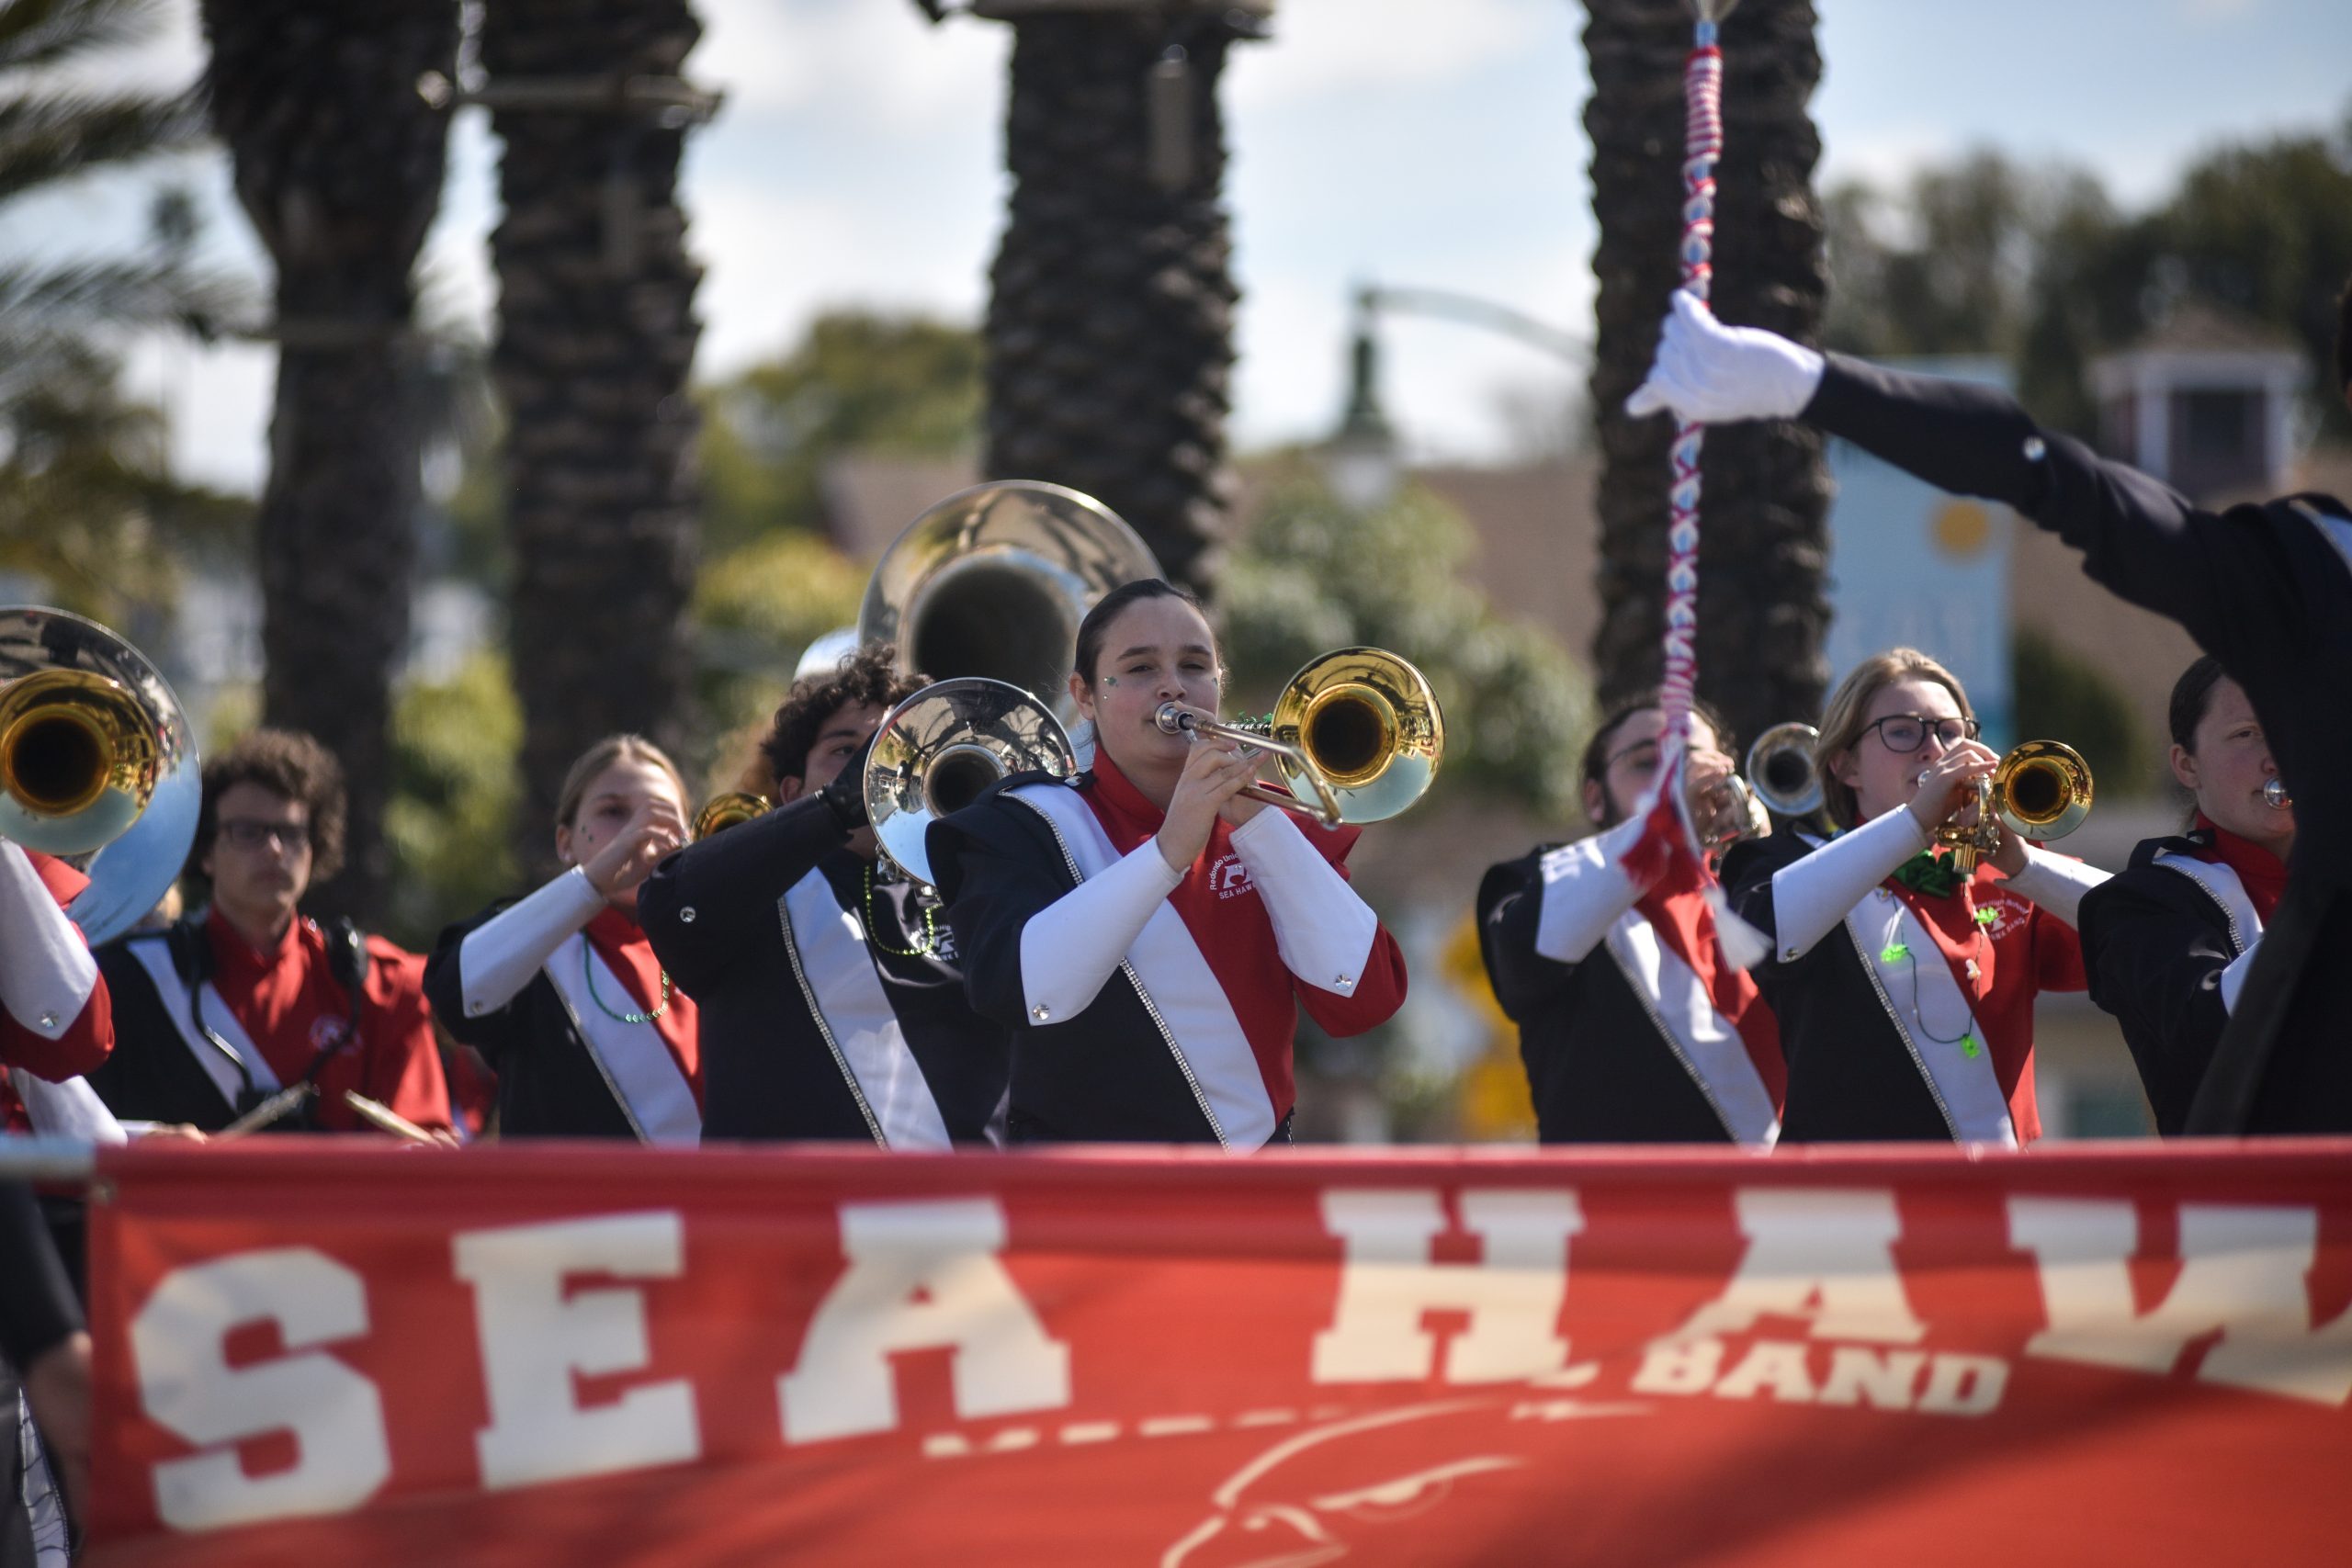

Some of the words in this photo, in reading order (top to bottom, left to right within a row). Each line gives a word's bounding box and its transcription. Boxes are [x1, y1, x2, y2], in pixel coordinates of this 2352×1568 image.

[1209, 859, 1224, 890] Redondo
[1218, 889, 1235, 899] SEA
[130, 1195, 1071, 1532] SEA
[1629, 1340, 2010, 1417] BAND
